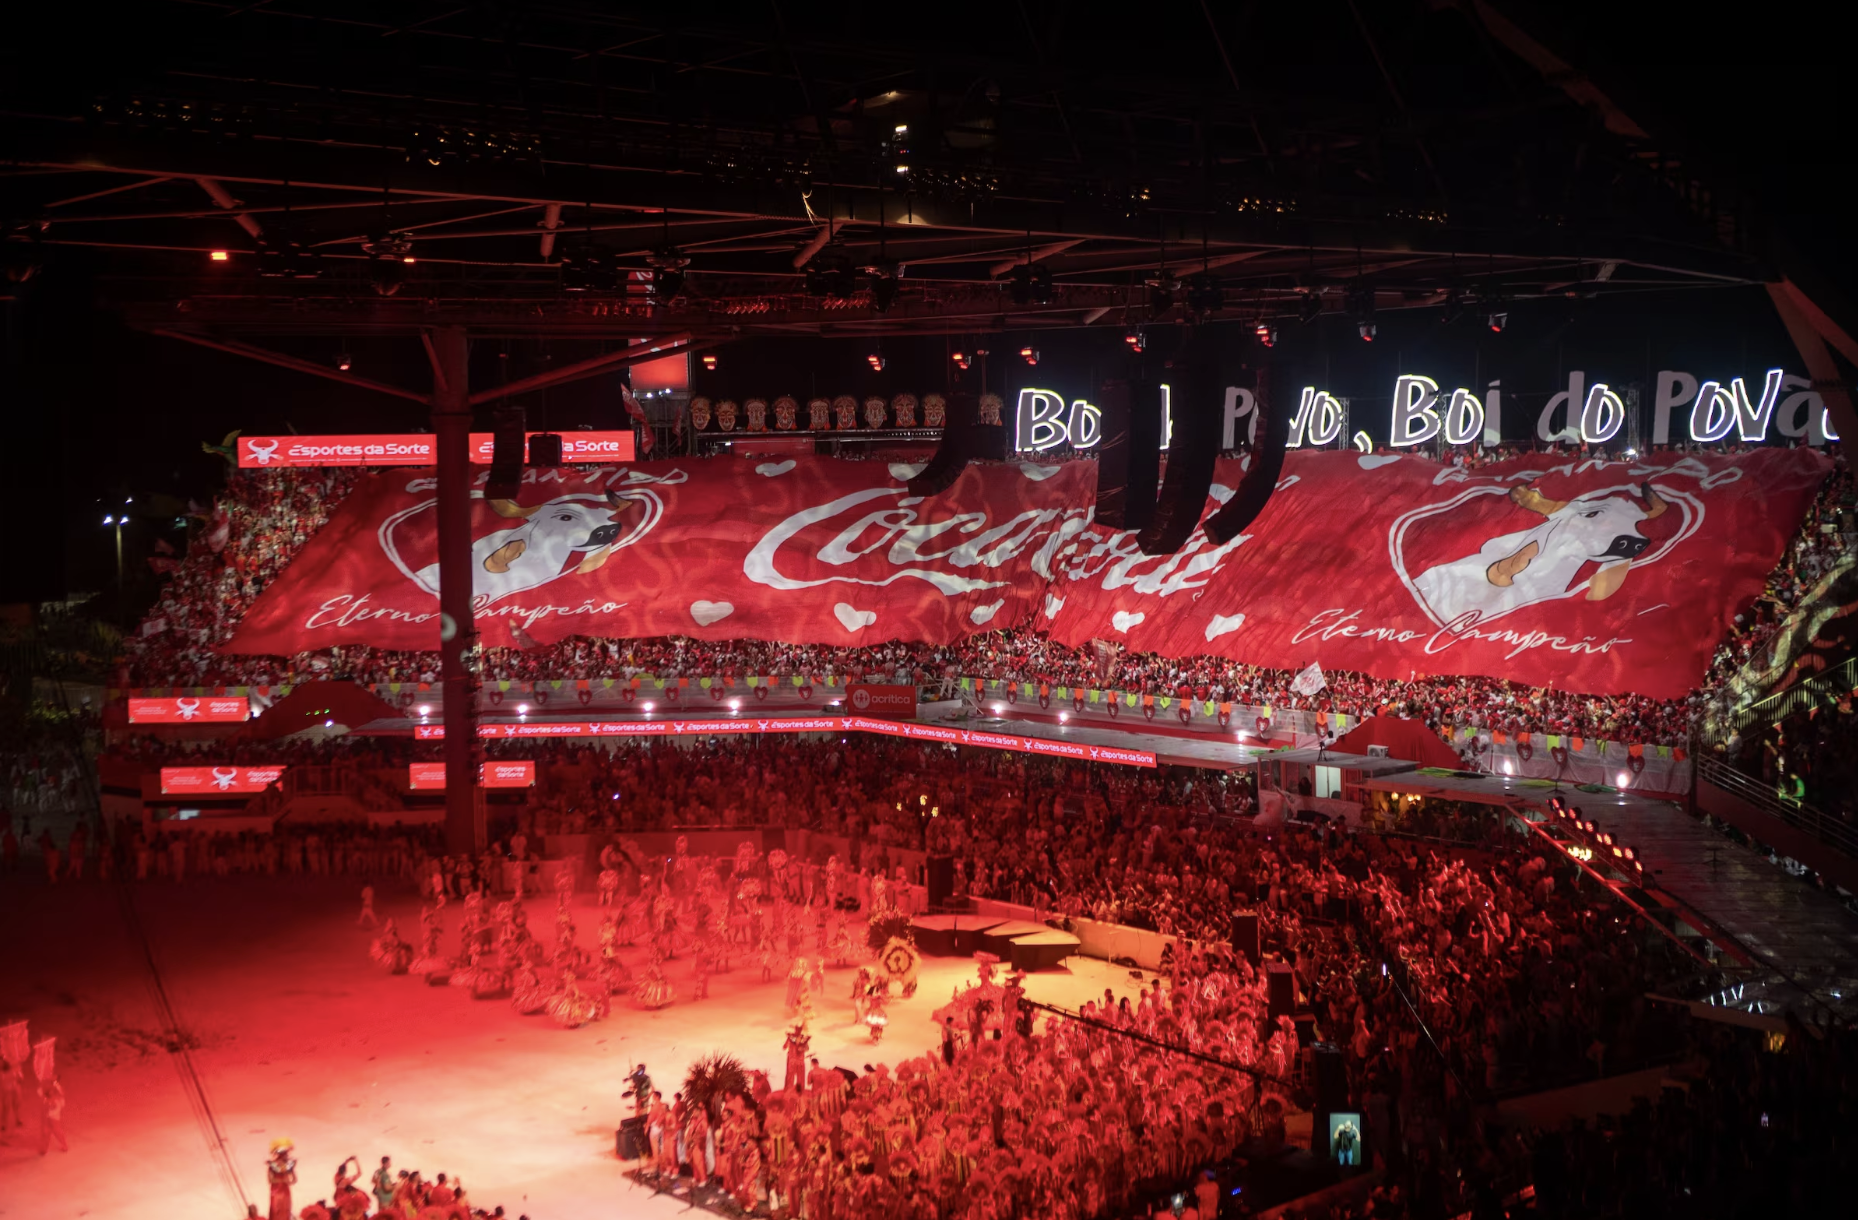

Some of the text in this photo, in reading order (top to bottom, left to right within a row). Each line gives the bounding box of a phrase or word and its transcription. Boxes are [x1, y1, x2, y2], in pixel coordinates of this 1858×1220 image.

[1014, 387, 1102, 452] Bo
[1390, 374, 1500, 447] Boi
[1536, 370, 1626, 444] do
[288, 443, 430, 458] Esportes da Sorte
[575, 440, 619, 452] Sorte
[305, 592, 442, 630] Eterno
